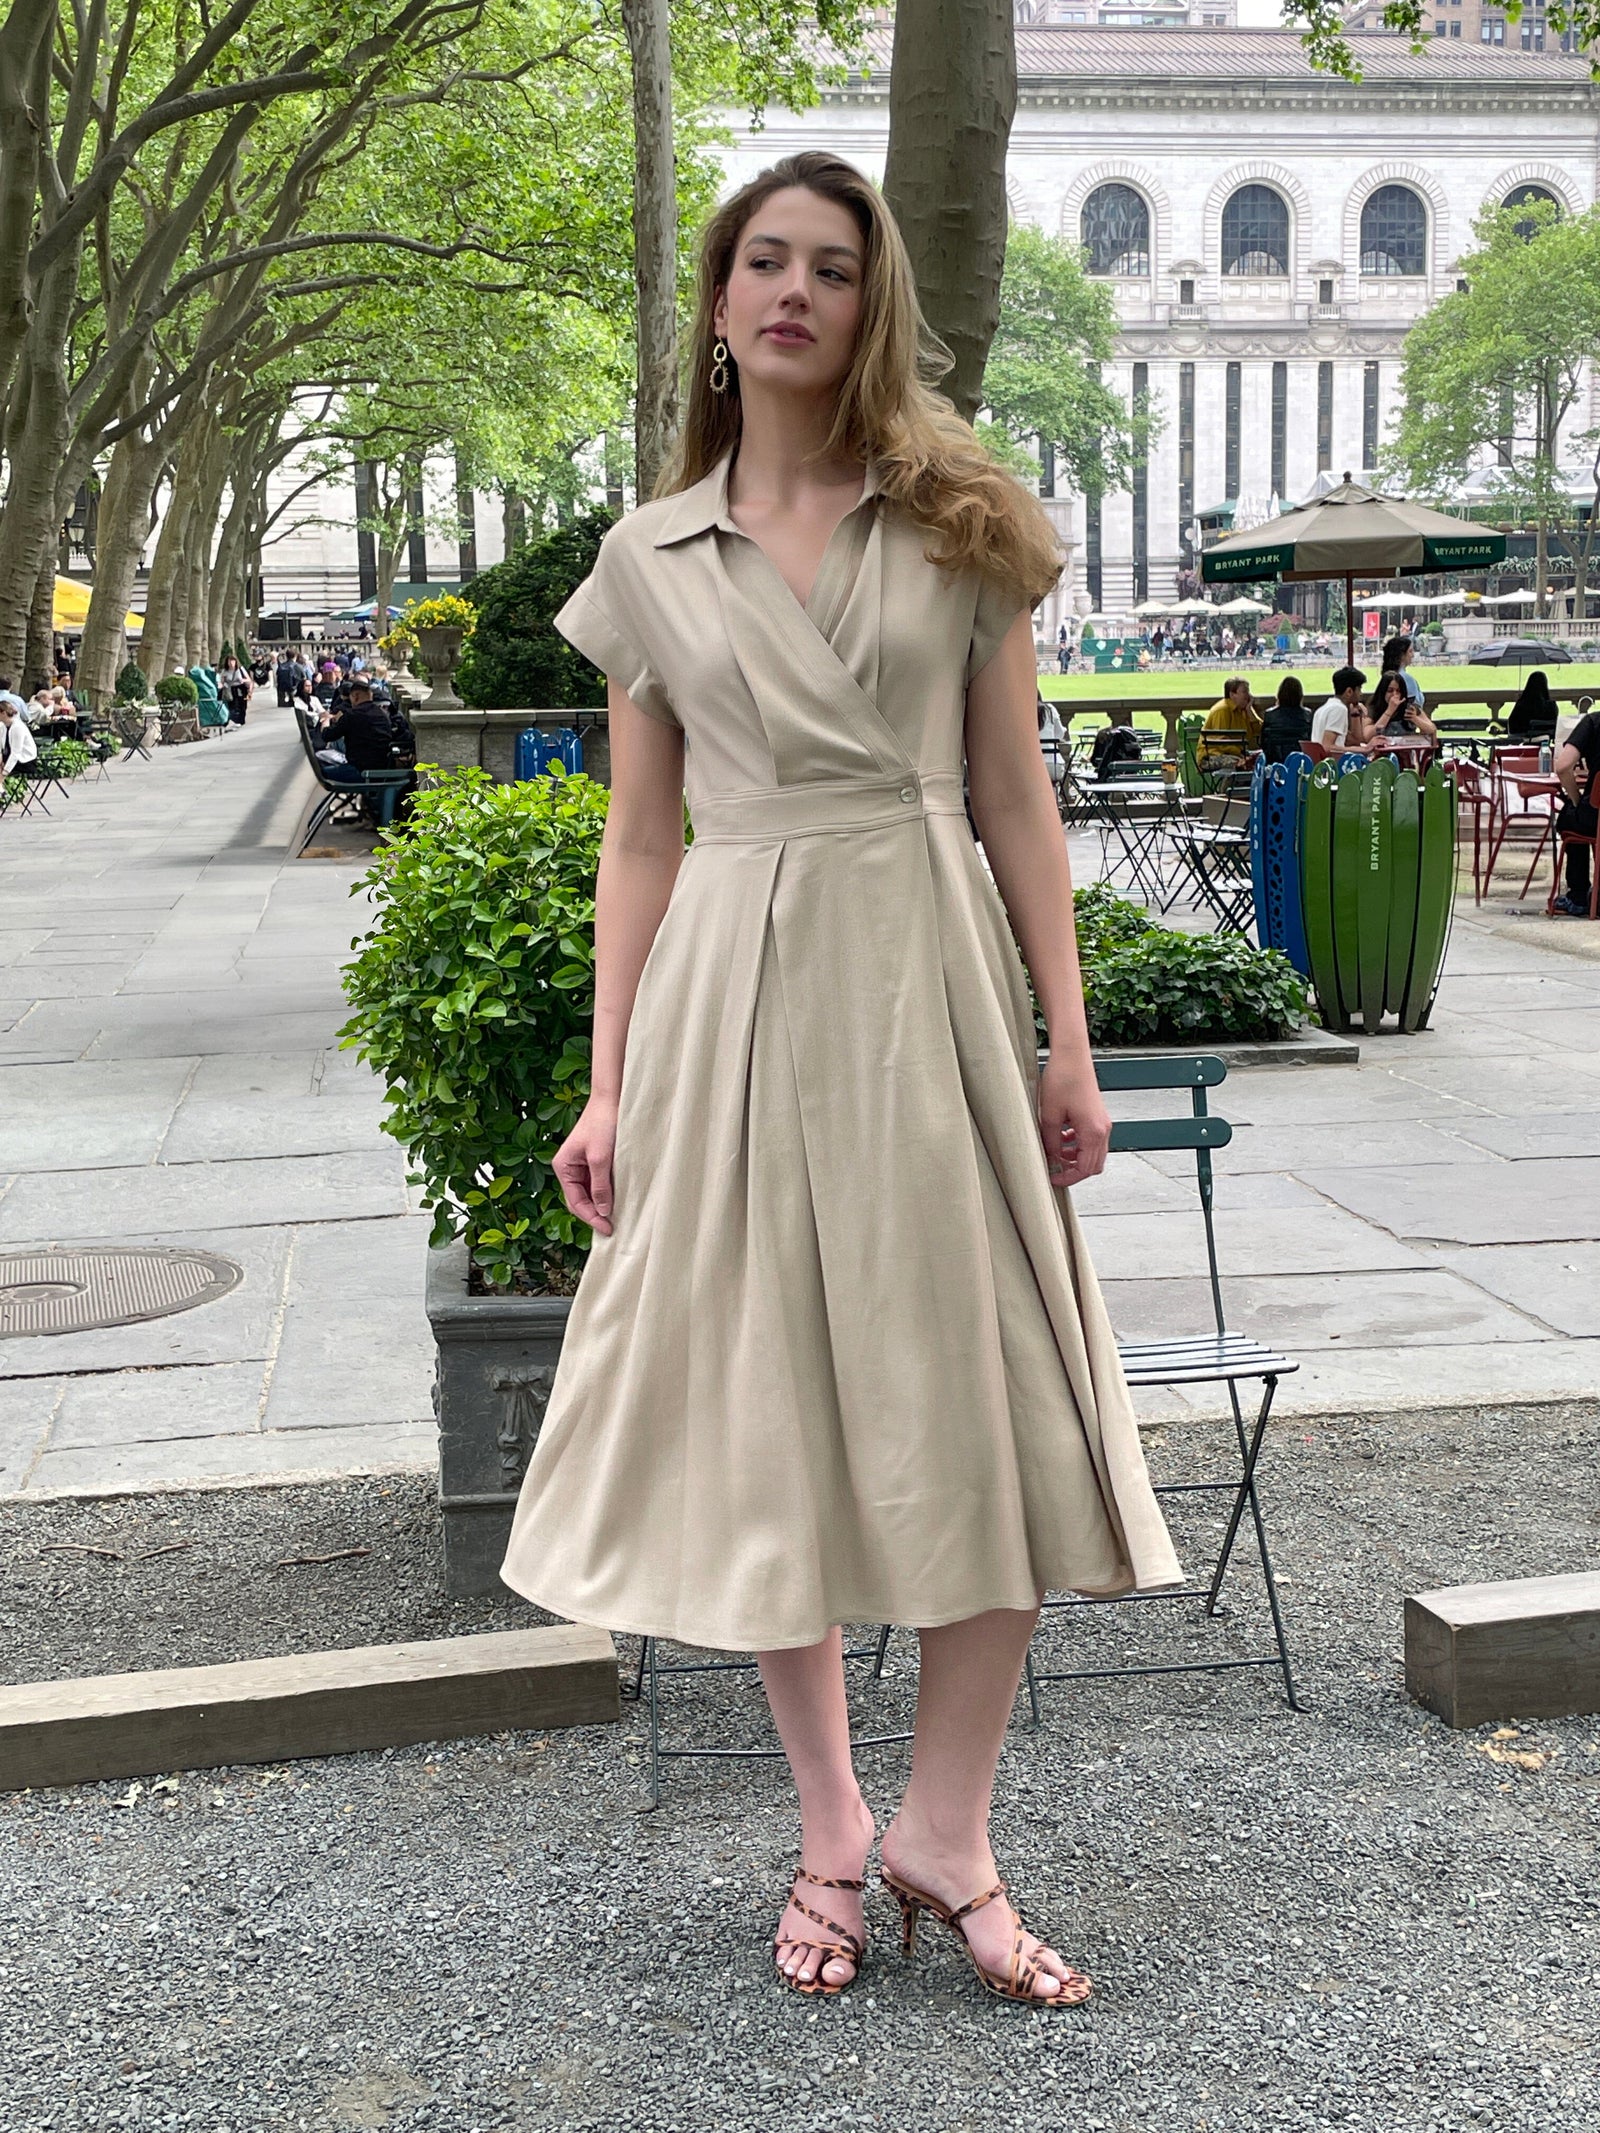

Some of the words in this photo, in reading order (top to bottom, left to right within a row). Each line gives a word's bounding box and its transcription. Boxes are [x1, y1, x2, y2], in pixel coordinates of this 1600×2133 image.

[1214, 557, 1252, 571] BRYANT
[1255, 554, 1280, 565] PARK
[1434, 546, 1467, 556] BRYANT
[1468, 545, 1492, 555] PARK
[1372, 777, 1382, 812] PARK
[1370, 817, 1380, 871] BRYANT
